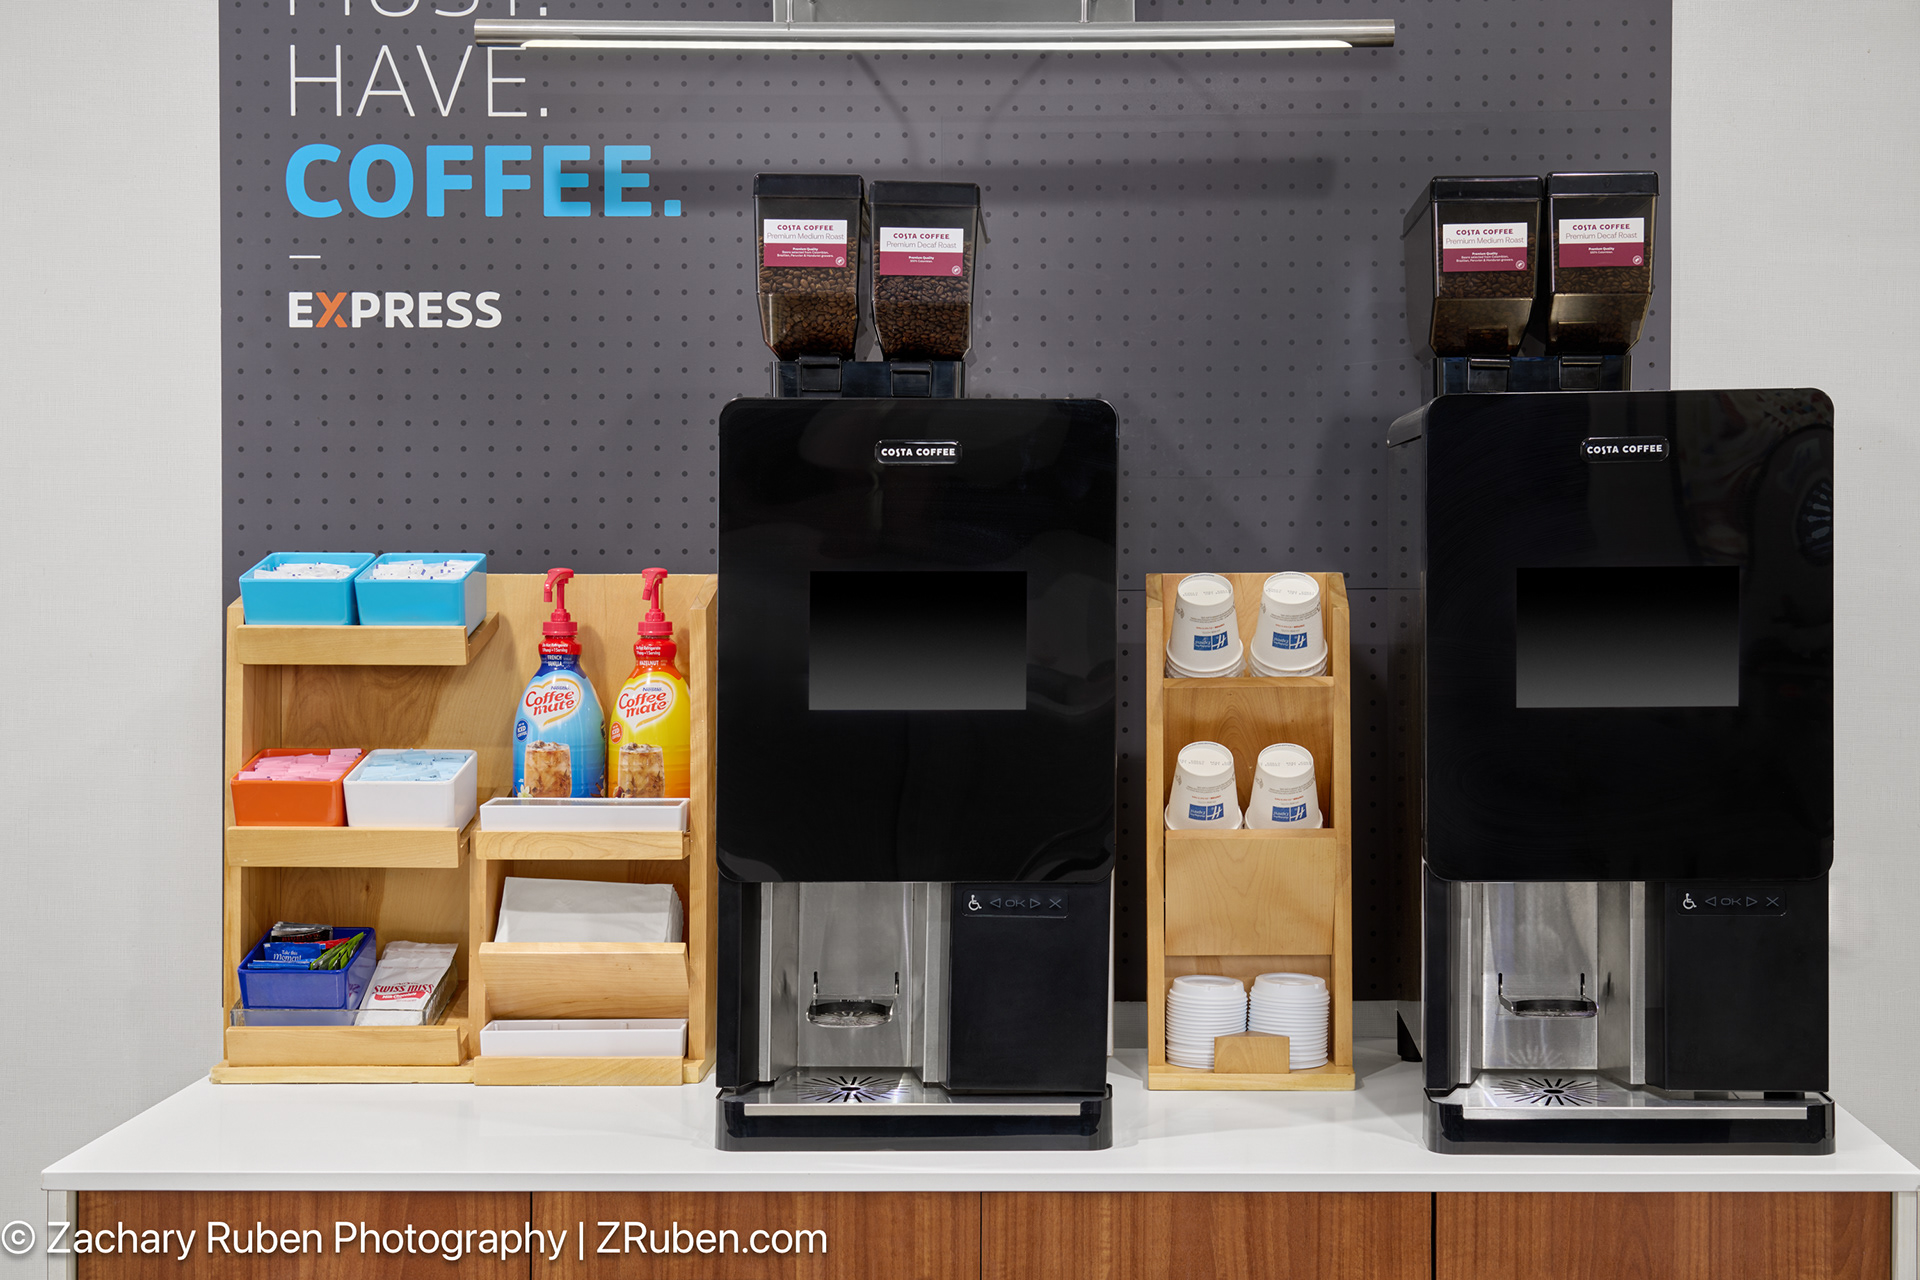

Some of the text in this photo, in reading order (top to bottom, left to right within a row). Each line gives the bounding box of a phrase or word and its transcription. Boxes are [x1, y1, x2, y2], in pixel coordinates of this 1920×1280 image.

[289, 45, 547, 117] HAVE.
[286, 144, 681, 218] COFFEE.
[289, 292, 502, 328] EXPRESS
[881, 448, 956, 457] COSTA COFFEE
[1587, 445, 1662, 454] COSTA COFFEE
[526, 691, 574, 707] Coffee
[619, 692, 667, 709] Coffee
[626, 701, 667, 718] mate
[1721, 898, 1741, 906] OK
